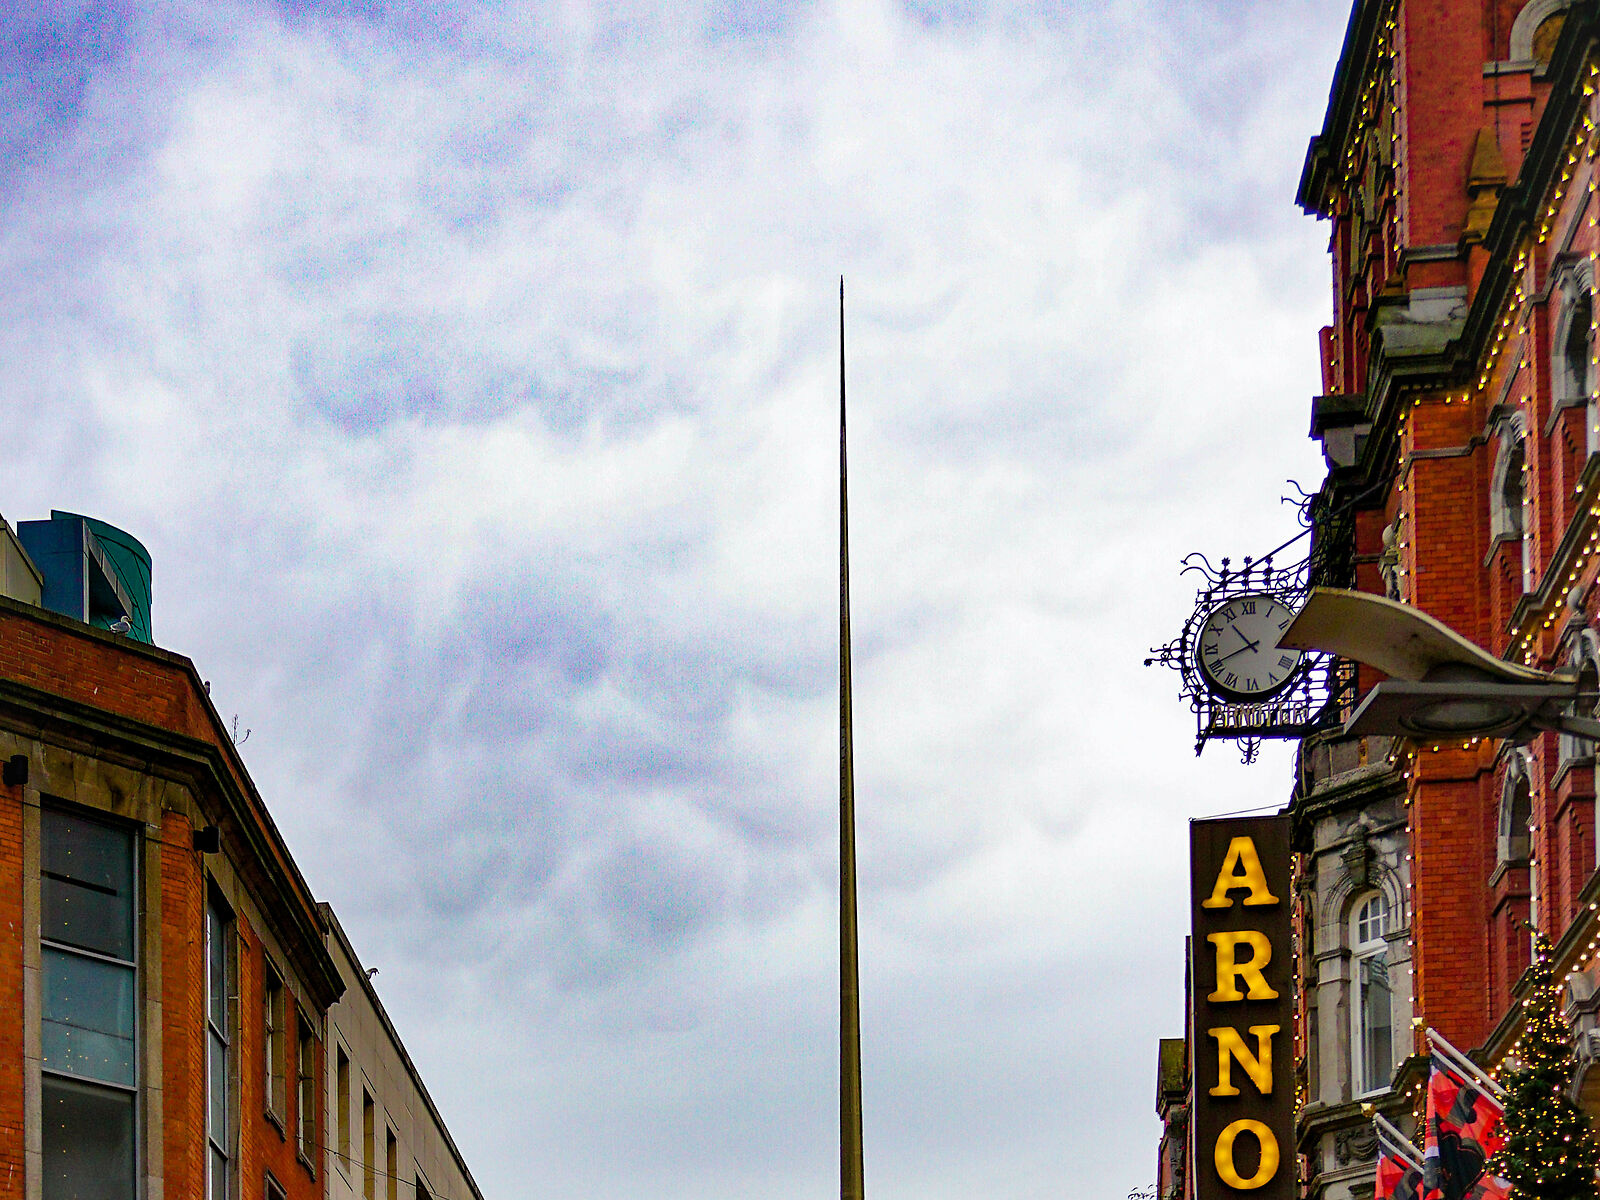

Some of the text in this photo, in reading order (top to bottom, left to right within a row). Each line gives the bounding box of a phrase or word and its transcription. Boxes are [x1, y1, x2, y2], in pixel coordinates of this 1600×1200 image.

[1221, 607, 1237, 623] XI
[1241, 601, 1256, 615] XII
[1208, 623, 1224, 637] X
[1204, 643, 1218, 655] IX
[1268, 672, 1279, 685] V
